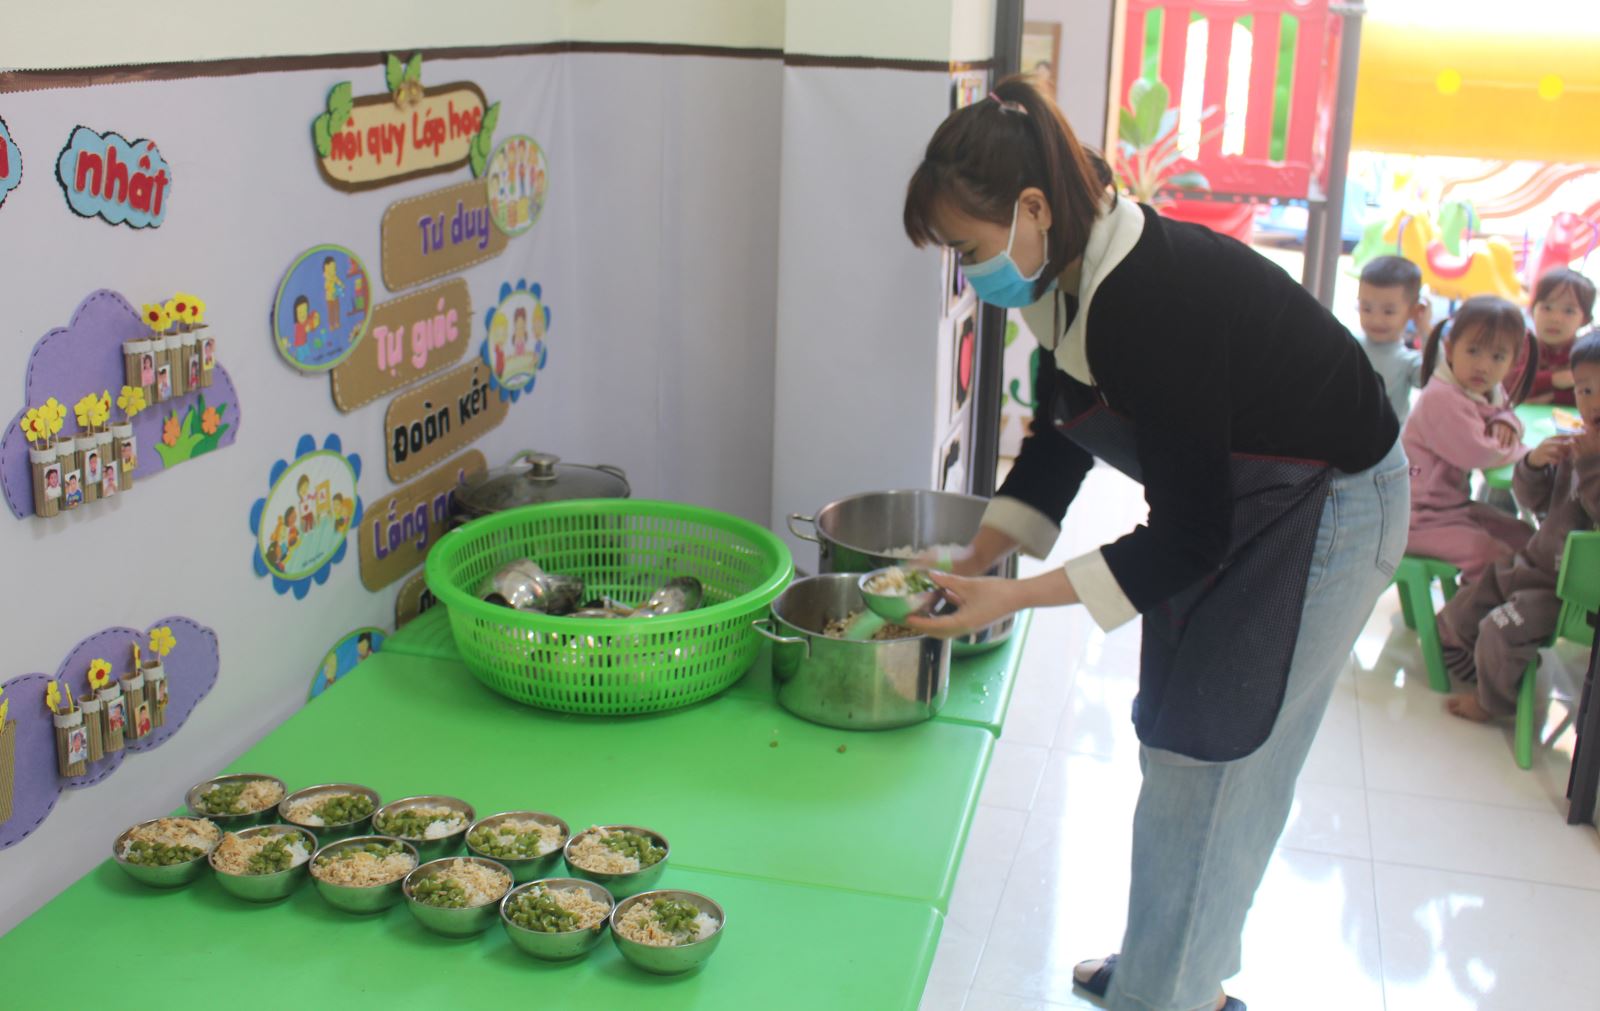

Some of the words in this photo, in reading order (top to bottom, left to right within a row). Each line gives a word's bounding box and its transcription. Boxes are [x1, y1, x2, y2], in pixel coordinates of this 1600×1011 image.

[366, 123, 406, 167] quy
[447, 100, 482, 144] học
[75, 141, 169, 217] nhất
[418, 212, 445, 256] Tư
[450, 200, 490, 251] duy
[372, 324, 405, 378] Tự
[411, 296, 459, 370] giác
[392, 401, 451, 464] Đoàn
[374, 499, 428, 560] Lắng
